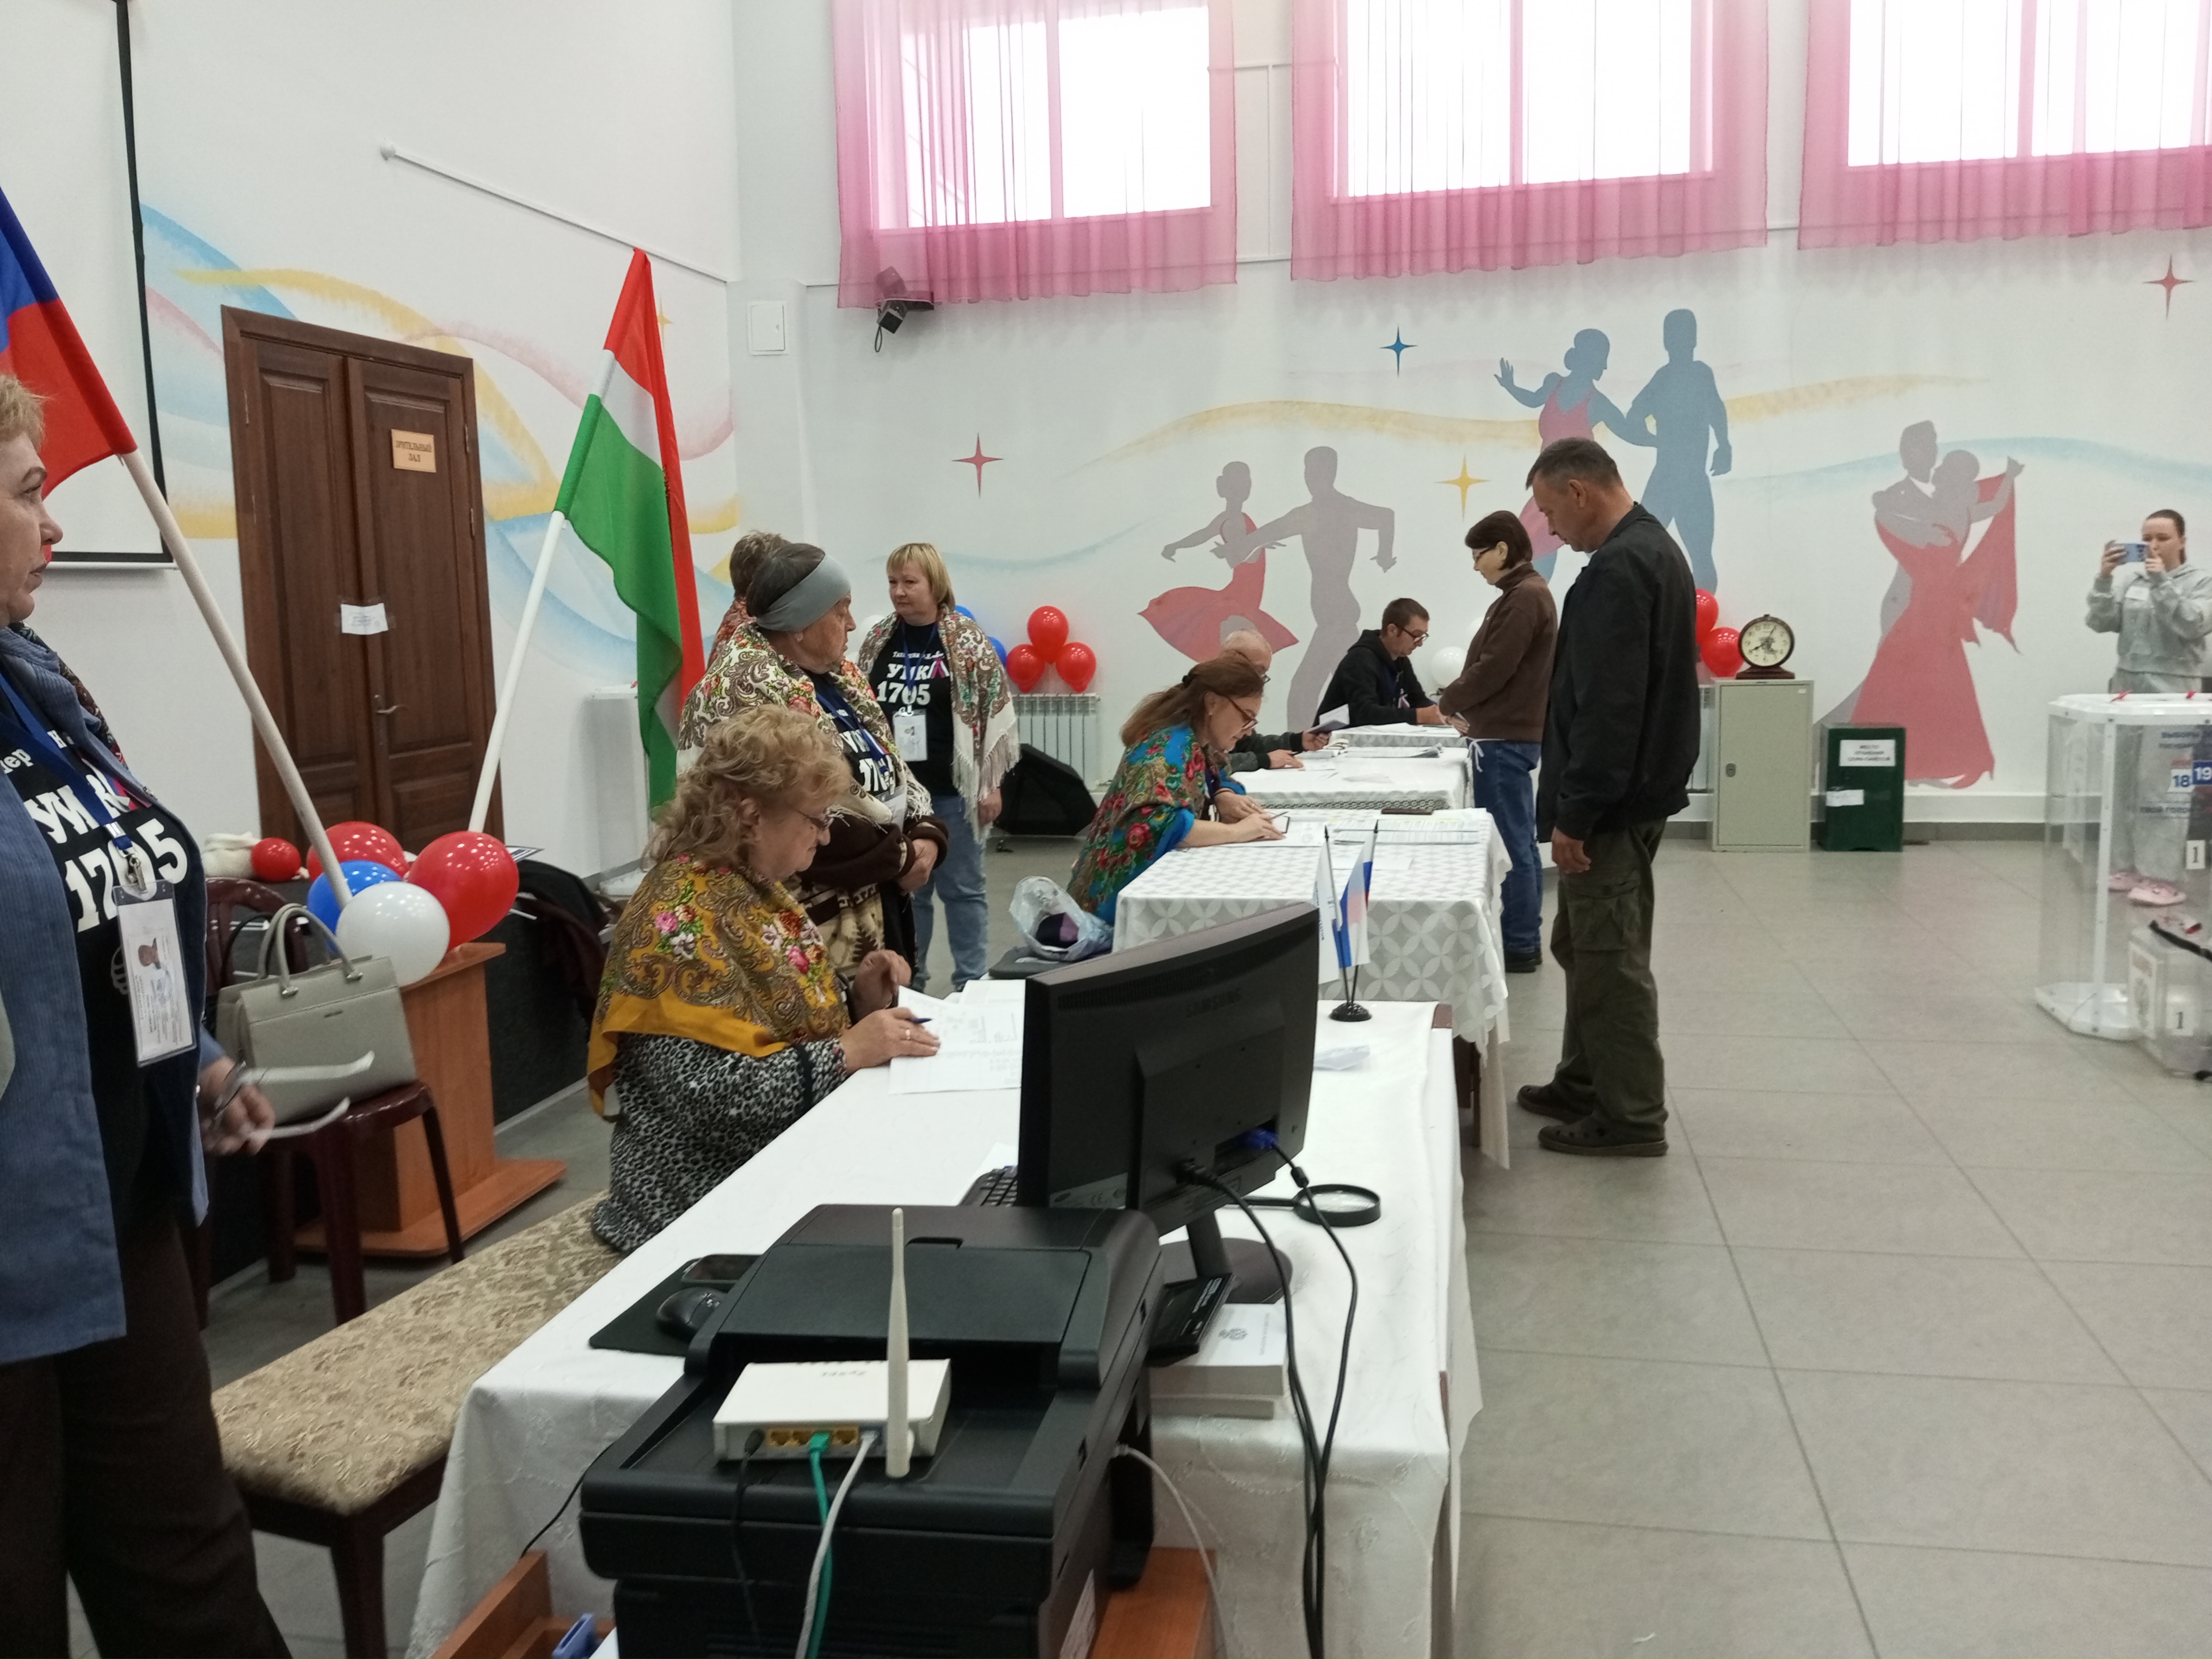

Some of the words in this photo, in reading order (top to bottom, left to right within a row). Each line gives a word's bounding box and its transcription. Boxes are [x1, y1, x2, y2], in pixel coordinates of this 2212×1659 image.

[877, 680, 931, 705] 1705
[2173, 775, 2190, 788] 18
[2195, 766, 2212, 781] 19
[65, 818, 188, 933] 1705
